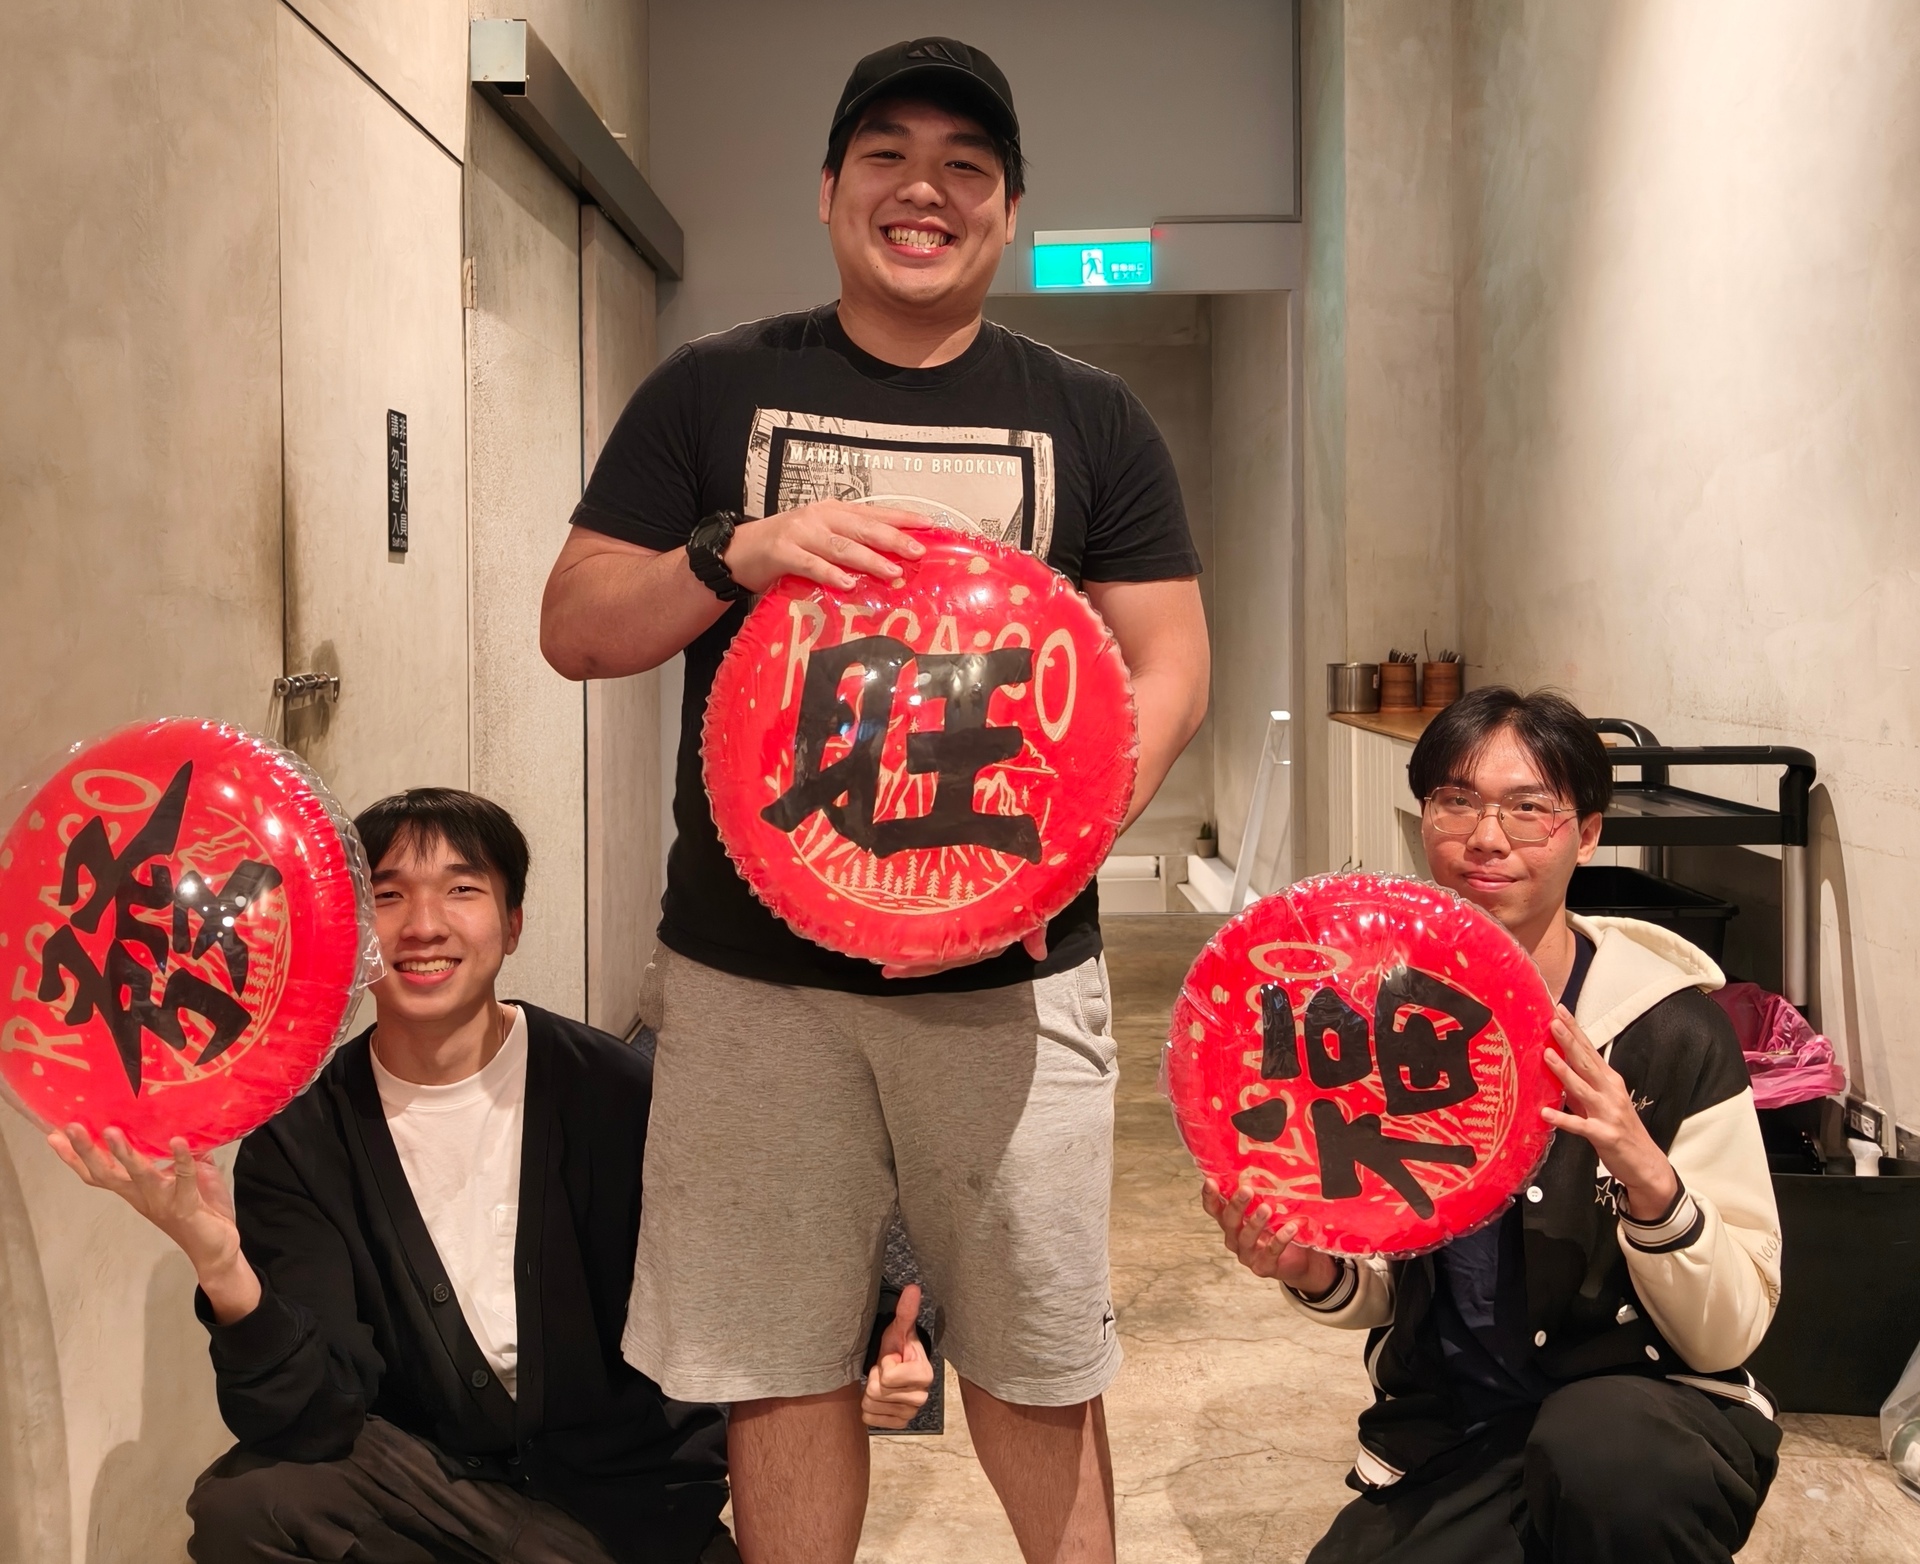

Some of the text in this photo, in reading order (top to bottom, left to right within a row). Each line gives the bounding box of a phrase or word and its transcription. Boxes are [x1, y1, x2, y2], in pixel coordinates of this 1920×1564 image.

[1113, 271, 1142, 280] EXIT
[391, 413, 400, 535] 請勿進入
[399, 416, 407, 536] 非工作人員
[790, 446, 1016, 477] MANHATTAN TO BROOKLYN
[760, 635, 1043, 865] 旺
[38, 759, 283, 1099] 發
[1230, 964, 1494, 1220] 福
